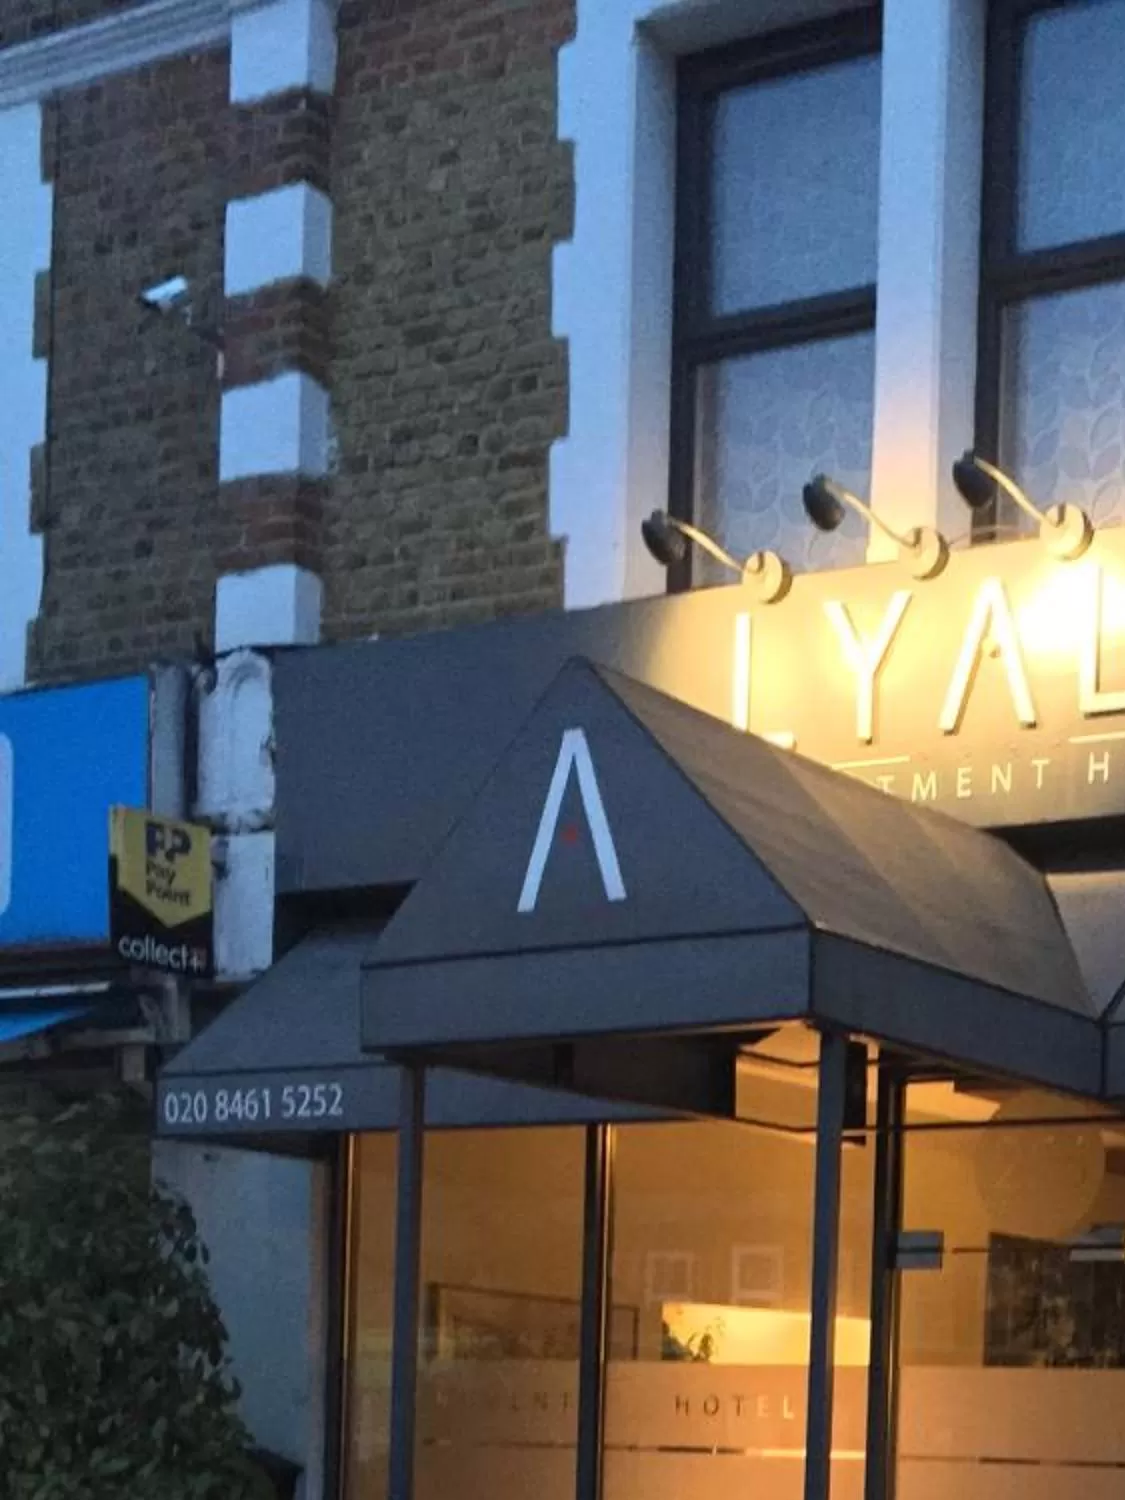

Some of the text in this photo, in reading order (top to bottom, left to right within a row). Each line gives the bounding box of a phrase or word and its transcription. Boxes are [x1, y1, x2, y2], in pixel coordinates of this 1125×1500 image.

[874, 757, 1052, 803] TMENT
[164, 1082, 344, 1124] 020 8461 5252
[674, 1393, 795, 1420] HOTEL
